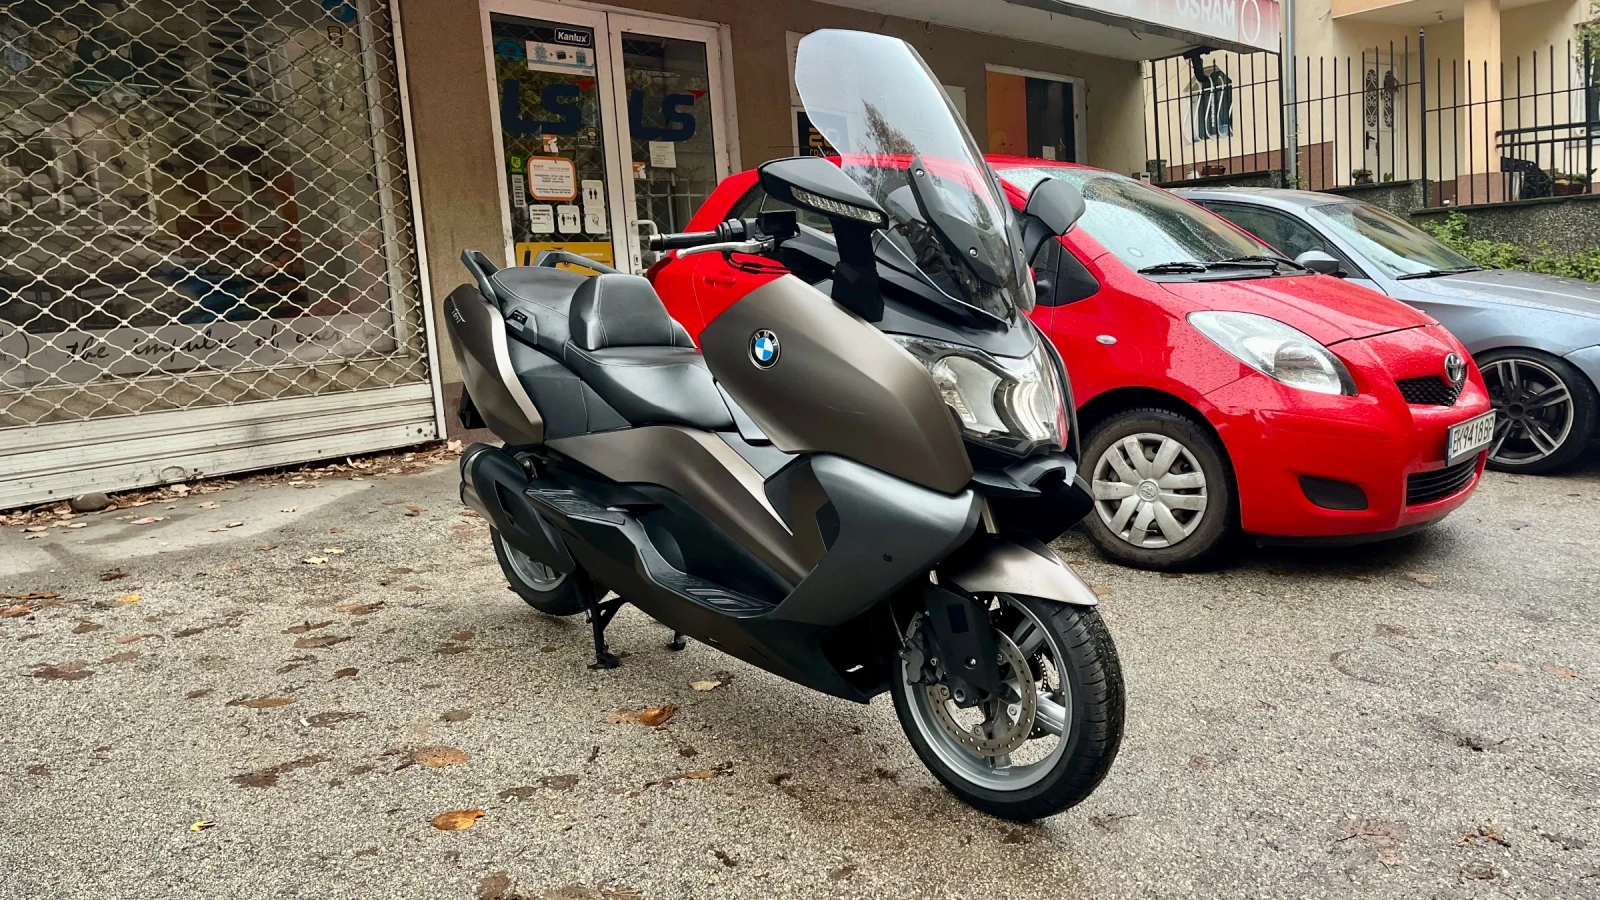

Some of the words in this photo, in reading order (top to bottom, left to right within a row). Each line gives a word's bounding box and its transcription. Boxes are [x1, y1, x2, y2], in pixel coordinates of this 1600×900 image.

[1175, 0, 1235, 27] OSRAM
[557, 31, 587, 43] Kanlux
[502, 79, 582, 135] LS
[630, 89, 696, 142] LS
[65, 336, 110, 362] the
[754, 330, 778, 347] BMW
